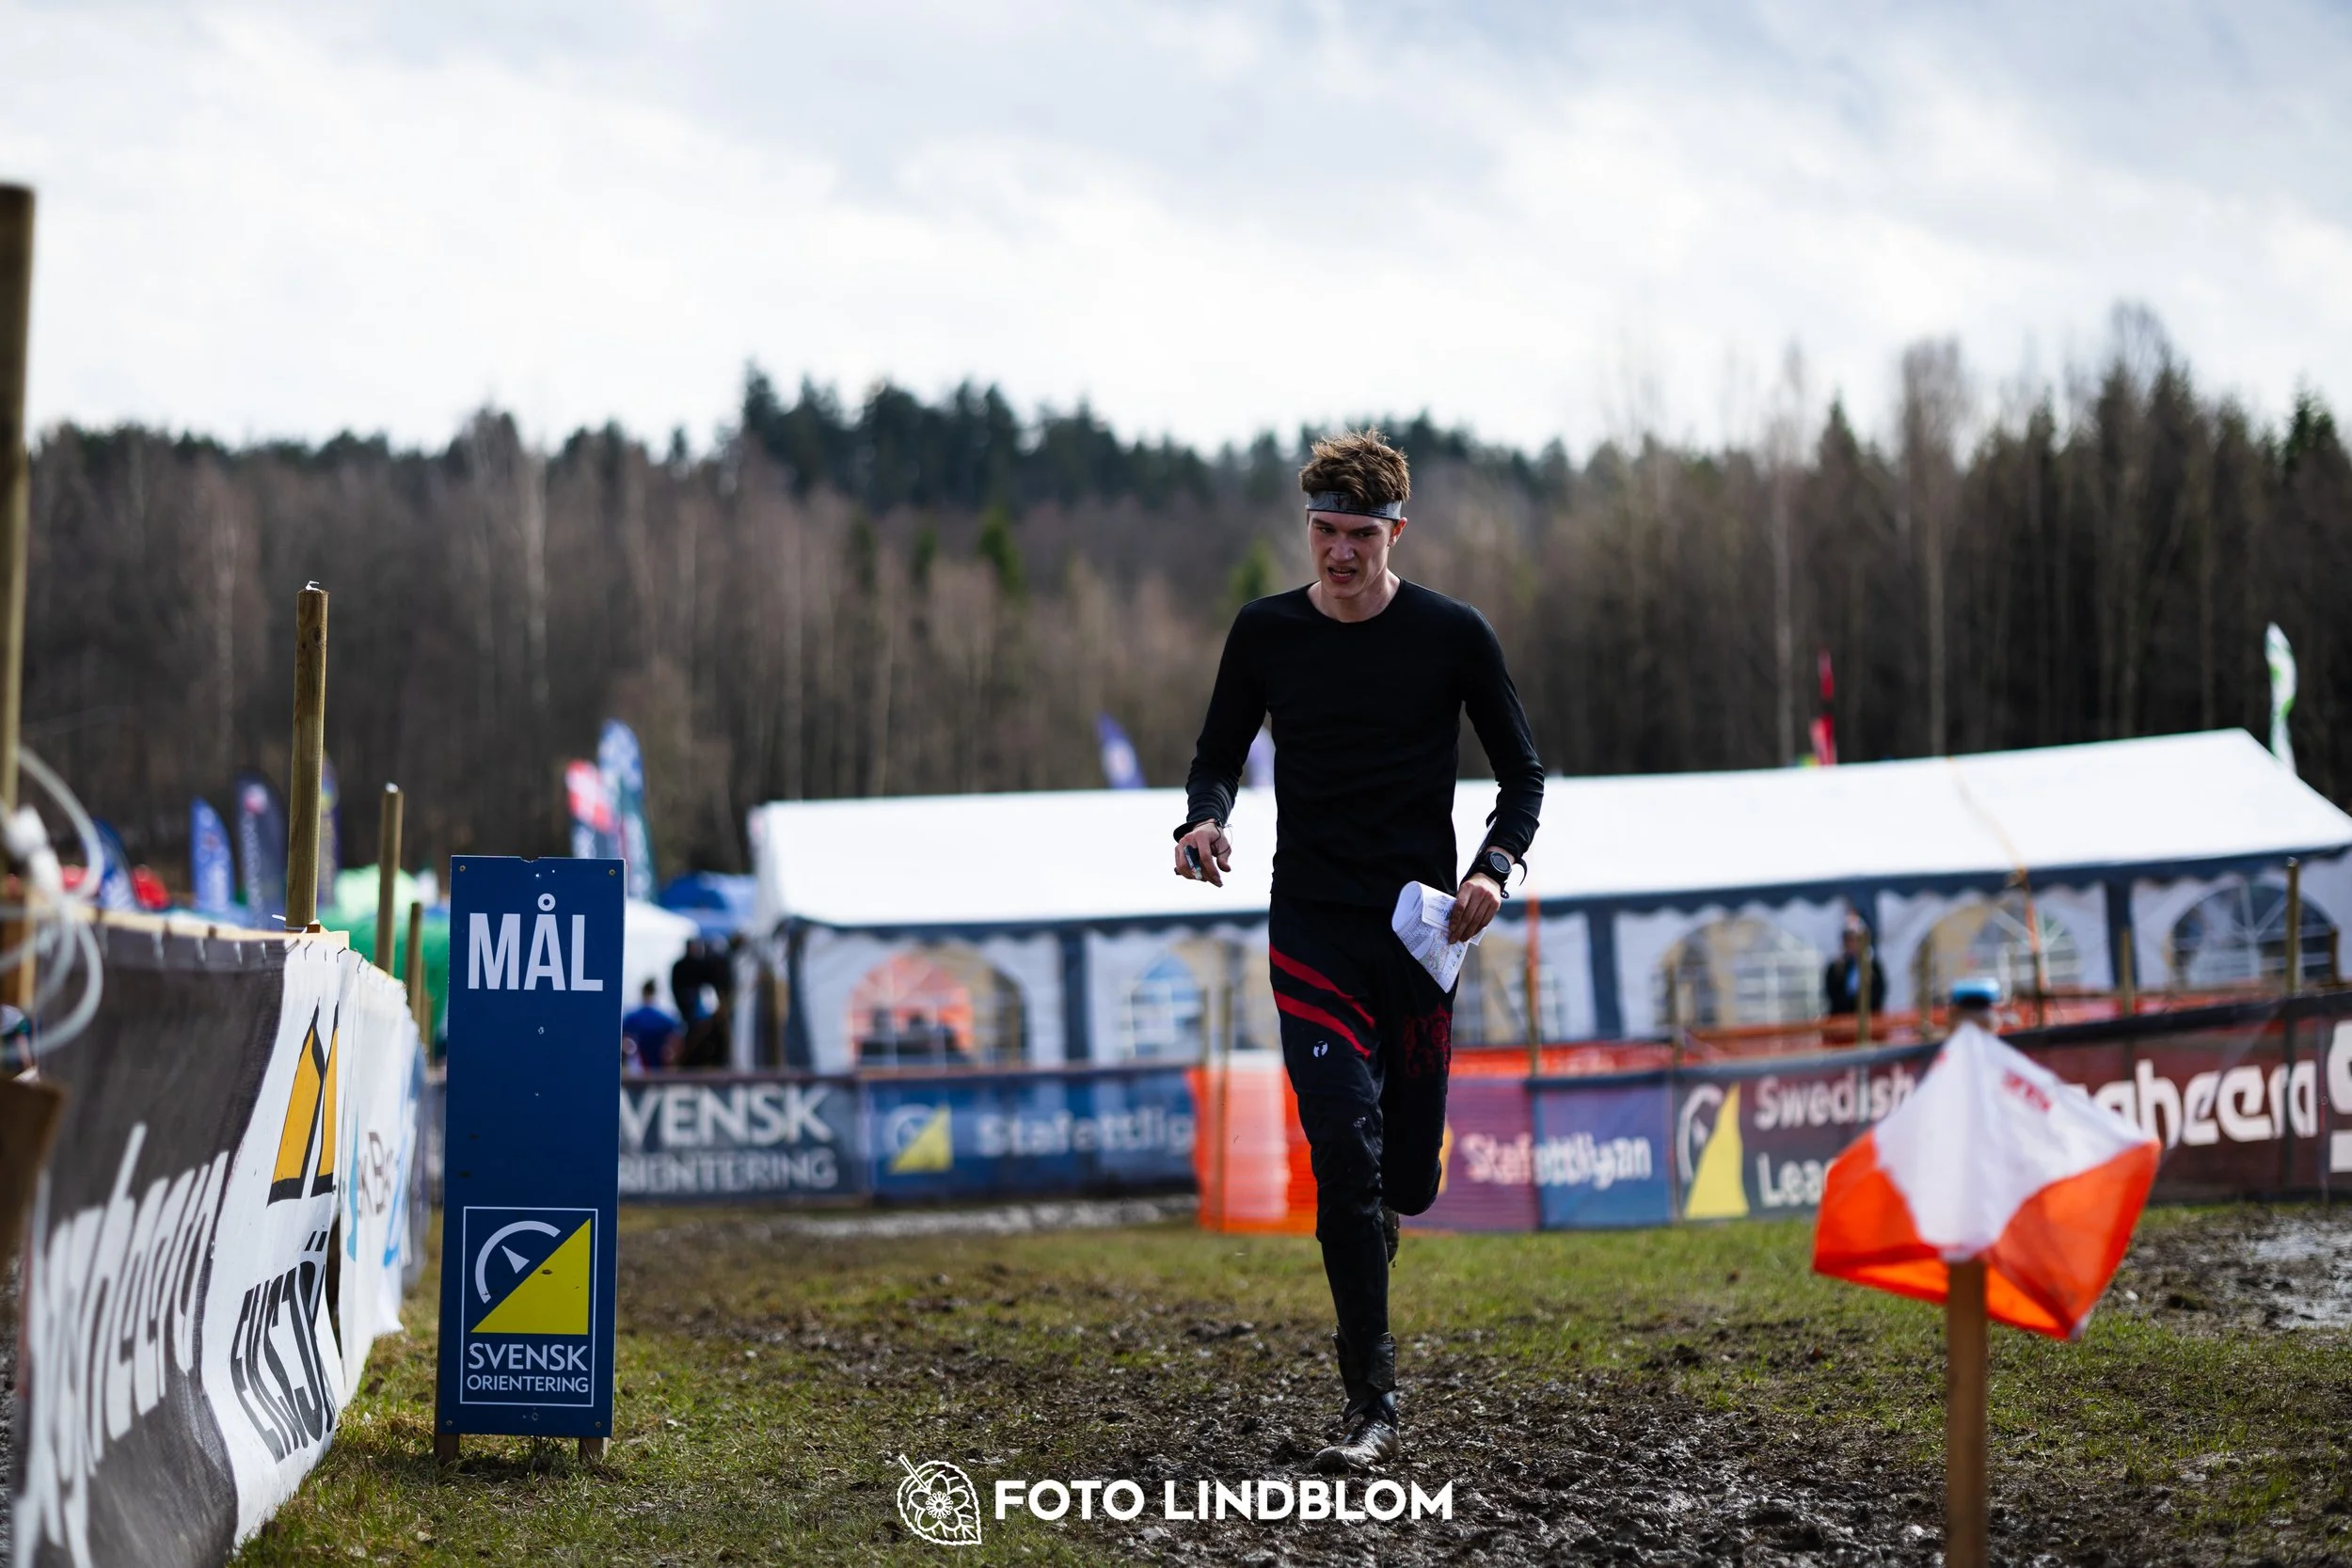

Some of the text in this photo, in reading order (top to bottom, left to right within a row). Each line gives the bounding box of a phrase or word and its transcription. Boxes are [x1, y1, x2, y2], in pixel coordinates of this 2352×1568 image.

[468, 893, 604, 991] MÅL
[620, 1083, 834, 1148] VENSK
[1755, 1063, 1916, 1131] Swedish
[618, 1148, 838, 1193] RIENTERING
[1756, 1151, 1833, 1208] Lea
[466, 1374, 590, 1393] ORIENTERING
[468, 1342, 589, 1371] SVENSK
